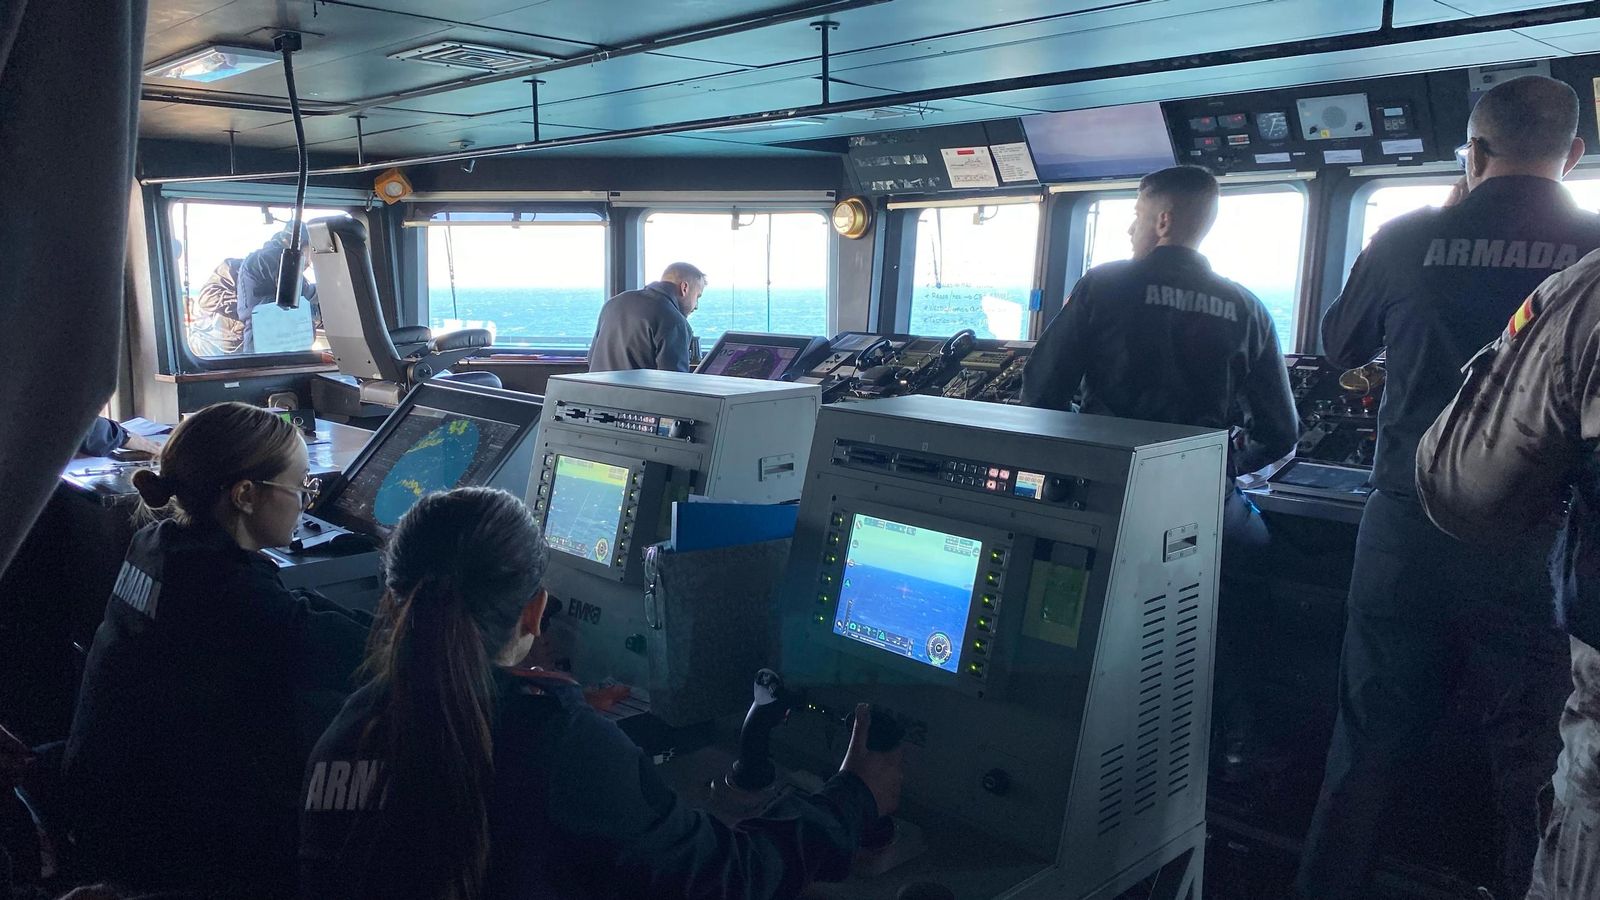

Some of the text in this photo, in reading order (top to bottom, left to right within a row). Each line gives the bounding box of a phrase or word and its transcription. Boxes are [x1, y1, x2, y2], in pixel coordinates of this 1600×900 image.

[1423, 238, 1577, 269] ARMADA
[1145, 284, 1238, 322] ARMADA
[113, 560, 161, 619] RMADA
